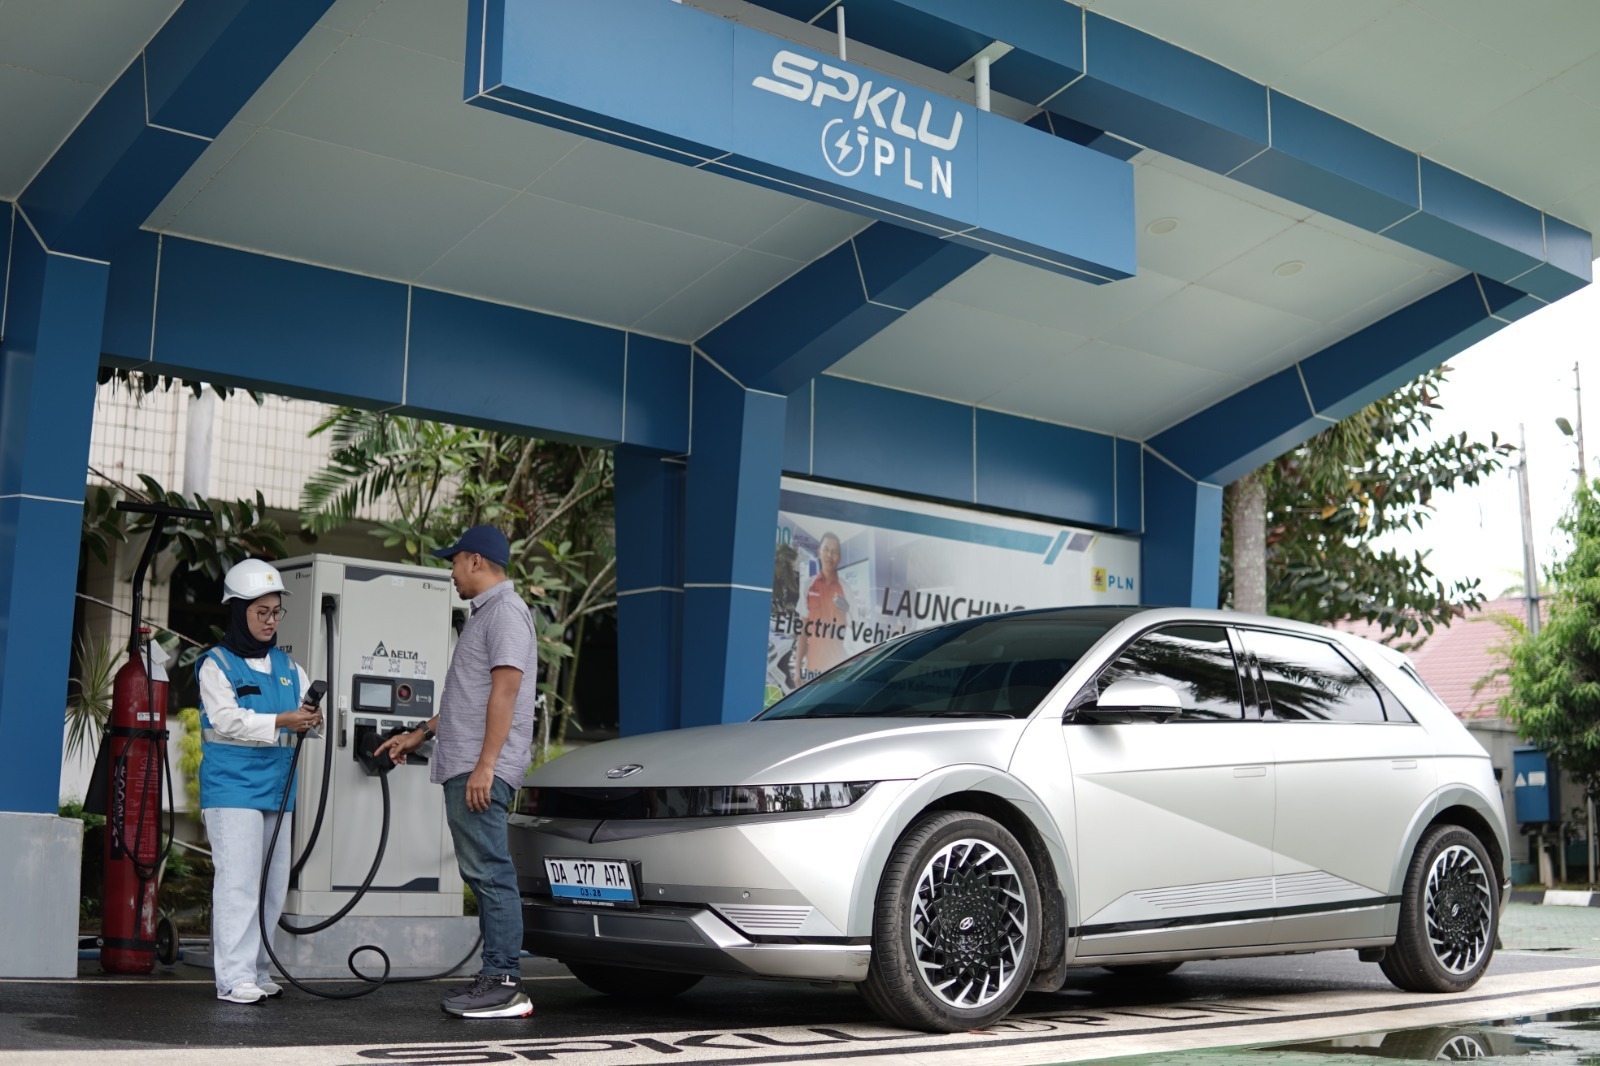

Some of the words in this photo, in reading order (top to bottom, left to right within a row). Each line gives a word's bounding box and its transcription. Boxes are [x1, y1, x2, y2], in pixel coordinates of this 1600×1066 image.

[752, 50, 963, 151] SPKLU
[874, 136, 952, 198] PLN
[1108, 575, 1134, 591] PLN
[881, 587, 1026, 622] LAUNCHI
[774, 612, 846, 640] Electric
[851, 620, 906, 643] Vehi
[550, 863, 568, 884] DA
[574, 863, 595, 885] 177
[604, 864, 627, 887] ATA
